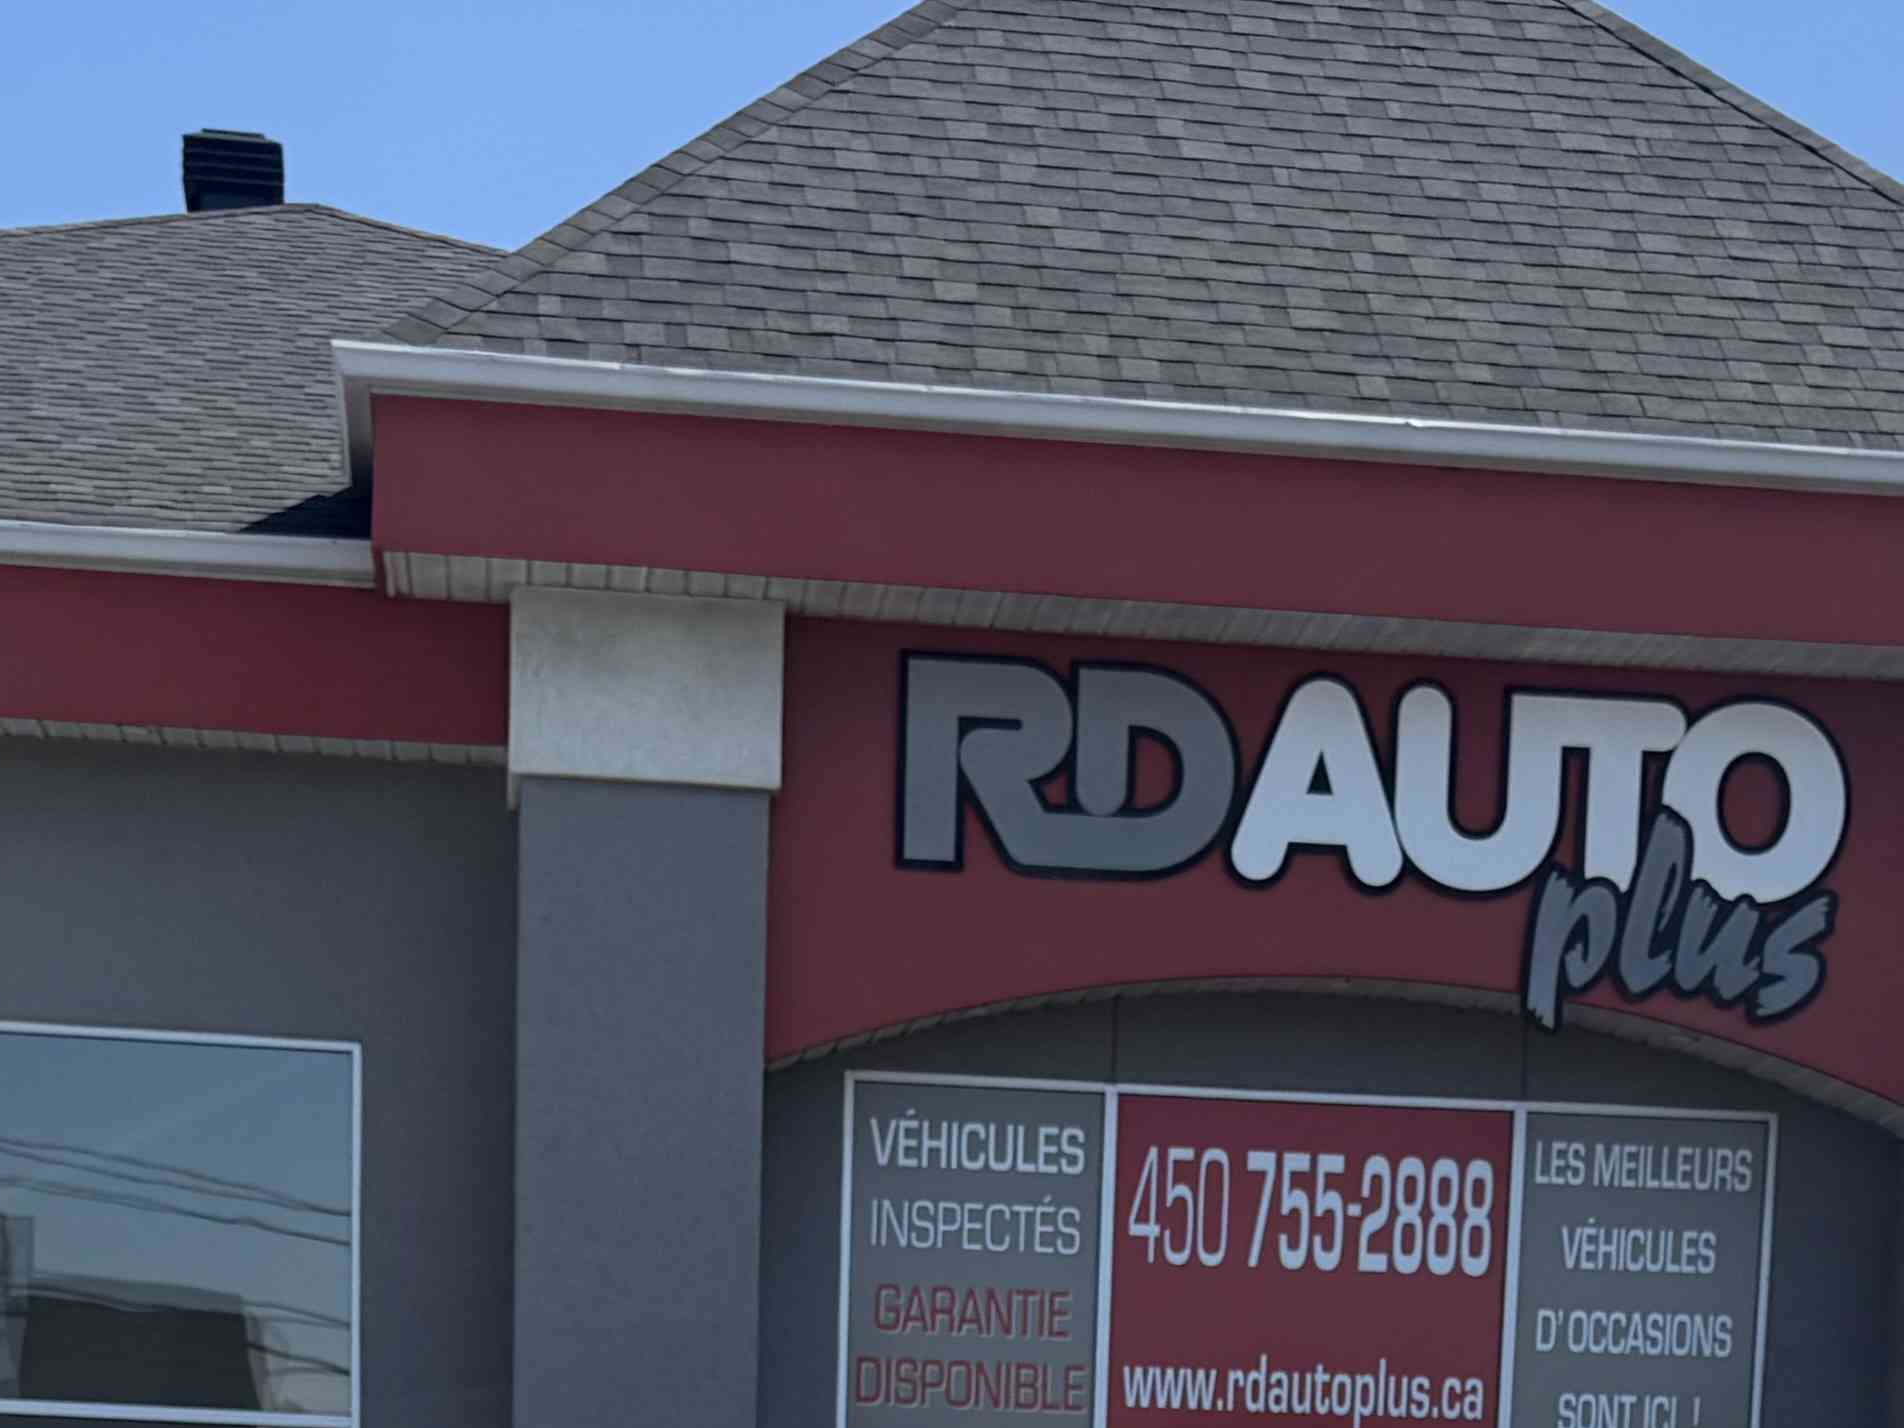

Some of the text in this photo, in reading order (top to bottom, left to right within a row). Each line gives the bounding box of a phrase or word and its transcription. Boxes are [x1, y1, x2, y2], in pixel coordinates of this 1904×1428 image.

[1530, 812, 1834, 1031] plus
[869, 1108, 1086, 1175] VÉHICULES
[1534, 1140, 1753, 1192] LES MEILLEURS
[869, 1194, 1081, 1256] INSPECTÉS
[1127, 1145, 1495, 1278] 450 755-2888
[1561, 1216, 1717, 1275] VÉHICULES
[873, 1282, 1073, 1342] GARANTIE
[855, 1355, 1089, 1416] DISPONIBLE
